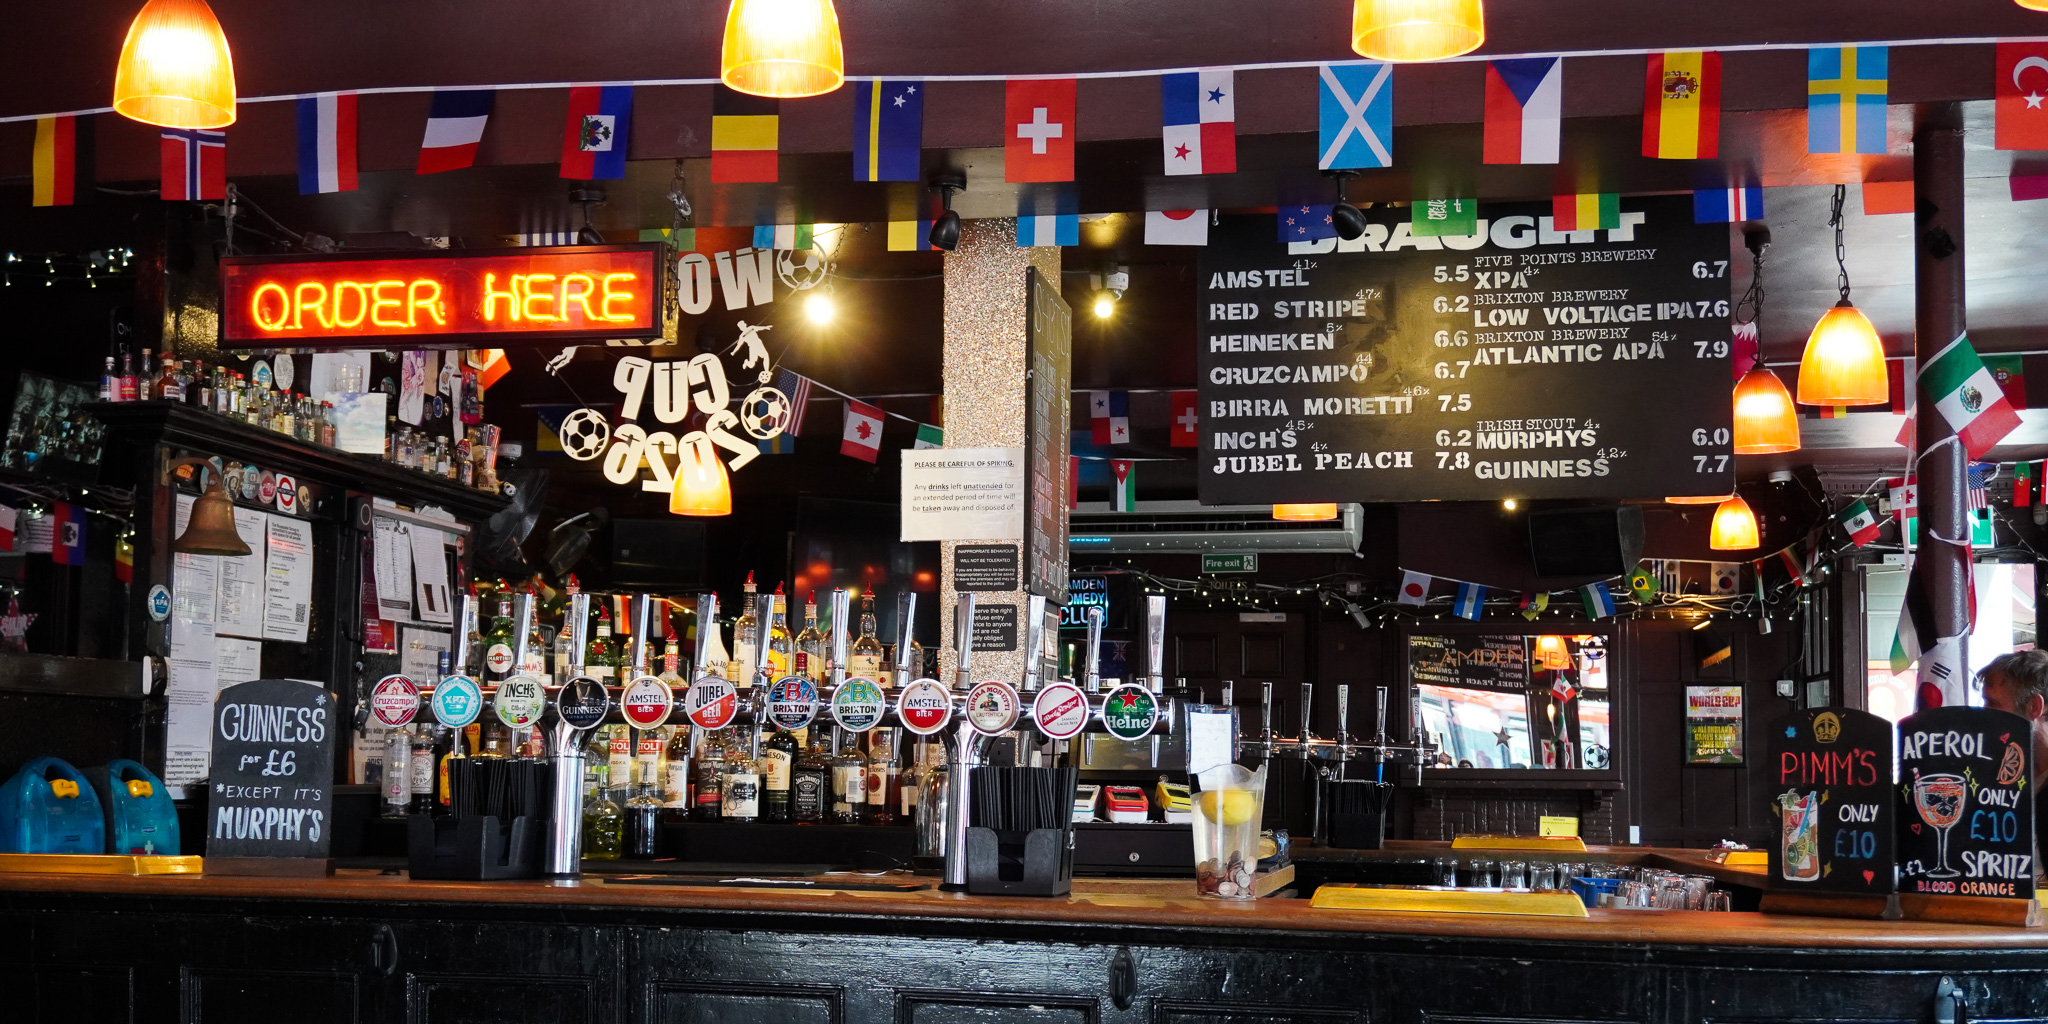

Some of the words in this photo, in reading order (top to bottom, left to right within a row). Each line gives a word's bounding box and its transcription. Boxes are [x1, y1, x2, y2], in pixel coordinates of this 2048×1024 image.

[1475, 256, 1513, 268] FIVE
[1520, 253, 1576, 265] POINTS
[1581, 249, 1657, 263] BREWERY
[1209, 270, 1309, 289] AMSTEL
[1434, 265, 1469, 283] 5.5
[1474, 271, 1529, 290] XPA
[1524, 266, 1540, 276] 4%
[1692, 261, 1728, 279] 6.7
[252, 279, 446, 331] ORDER
[483, 272, 636, 322] HERE
[1474, 292, 1545, 306] BRIXTON
[1551, 289, 1629, 302] BREWERY
[1210, 303, 1259, 321] RED
[1274, 300, 1366, 318] STRIPE
[1433, 295, 1469, 313] 6.2
[1474, 308, 1529, 327] LOW
[1543, 304, 1651, 325] VOLTAGE
[1657, 301, 1694, 320] IPA
[1696, 301, 1730, 319] 7.6
[1326, 323, 1343, 333] 5%
[1474, 330, 1545, 344] BRIXTON
[1551, 328, 1630, 341] BREWERY
[1210, 333, 1334, 353] HEINEKEN
[1434, 330, 1469, 348] 6.6
[1473, 344, 1603, 366] ATLANTIC
[1612, 342, 1665, 361] APA
[1693, 341, 1729, 359] 7.9
[1210, 365, 1368, 385] CRUZCAMPO
[1434, 361, 1470, 379] 6.7
[1210, 399, 1289, 418] BIRRA
[1304, 396, 1412, 416] MORETTI
[1437, 394, 1471, 412] 7.5
[1477, 420, 1523, 431] IRISH
[1525, 418, 1575, 430] STOUT
[1214, 428, 1297, 449] INCH'S
[1435, 430, 1472, 447] 6.2
[1311, 441, 1328, 452] 4%
[1477, 430, 1597, 450] MURPHYS
[1692, 428, 1730, 446] 6.0
[1596, 448, 1627, 458] 4.2%
[987, 459, 1015, 467] SPIKING.
[1213, 454, 1302, 474] JUBEL
[1315, 451, 1413, 470] PEACH
[1435, 452, 1470, 470] 7.8
[1475, 458, 1610, 480] GUINNESS
[1693, 455, 1729, 473] 7.7
[963, 482, 1003, 490] unattended
[955, 494, 978, 502] period
[976, 504, 1005, 512] disposed
[1224, 559, 1240, 567] exit
[1068, 579, 1104, 589] AMDEN
[155, 598, 168, 607] XPA
[1067, 592, 1104, 605] OMEDY
[445, 695, 466, 703] XPA
[504, 683, 535, 699] INCH'S
[629, 694, 663, 704] AMSTEL
[696, 685, 725, 709] JUBEL
[970, 689, 986, 711] BIRRA
[987, 687, 1010, 711] MORETTI
[374, 696, 415, 706] Cruzcampo
[773, 704, 810, 713] BRIXTON
[839, 704, 877, 714] BRIXTON
[907, 697, 942, 708] AMSTEL
[1689, 696, 1721, 707] WORLD
[1722, 696, 1740, 707] CUP
[562, 705, 602, 715] GUINNESS
[702, 703, 721, 718] BEER
[1903, 731, 1993, 760] APEROL
[238, 754, 262, 771] for
[262, 749, 297, 776] £6
[1781, 748, 1877, 786] PIMM'S
[294, 788, 322, 801] IT'S
[1978, 788, 2020, 809] ONLY
[1838, 803, 1879, 823] ONLY
[215, 806, 324, 842] MURPHY'S
[1970, 809, 2018, 843] £10
[1835, 828, 1876, 859] £10
[1961, 850, 2031, 879] SPRITZ
[1917, 880, 1956, 893] BLOOD
[1960, 881, 2016, 896] ORANGE
